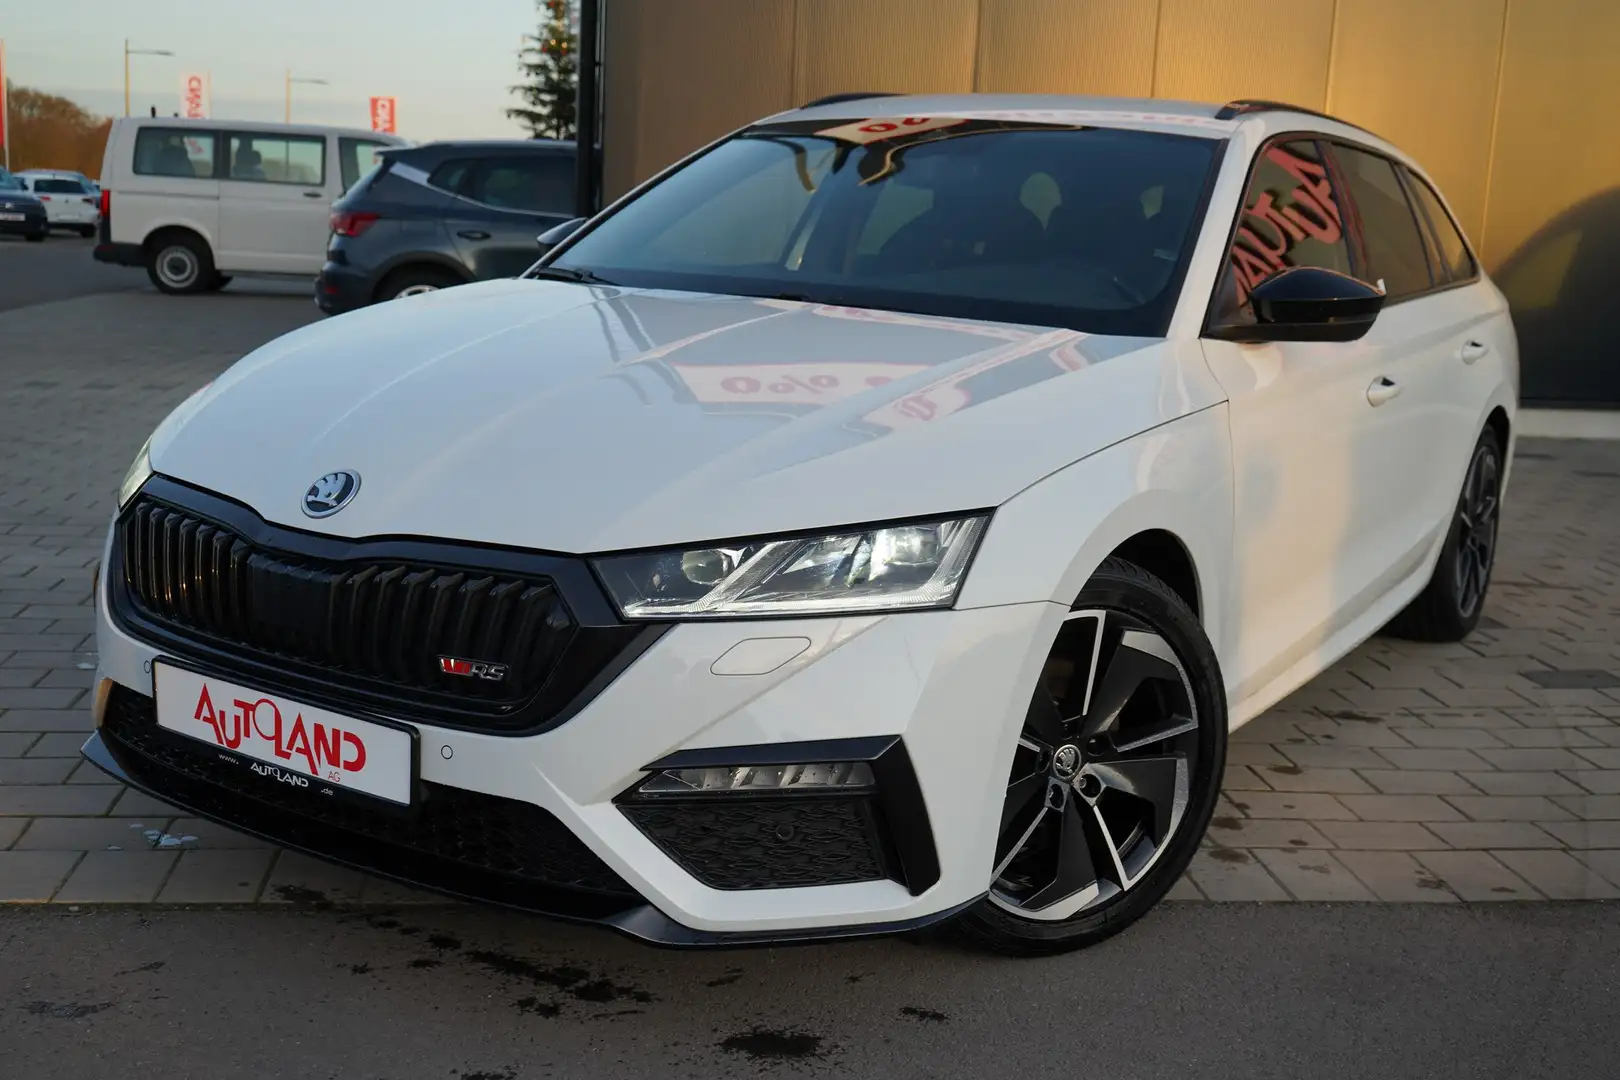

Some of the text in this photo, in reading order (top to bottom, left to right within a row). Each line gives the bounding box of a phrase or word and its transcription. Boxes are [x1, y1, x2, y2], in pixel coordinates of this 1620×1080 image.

[194, 683, 367, 783] AUTOLAND AG
[250, 762, 309, 787] AUTOLAND
